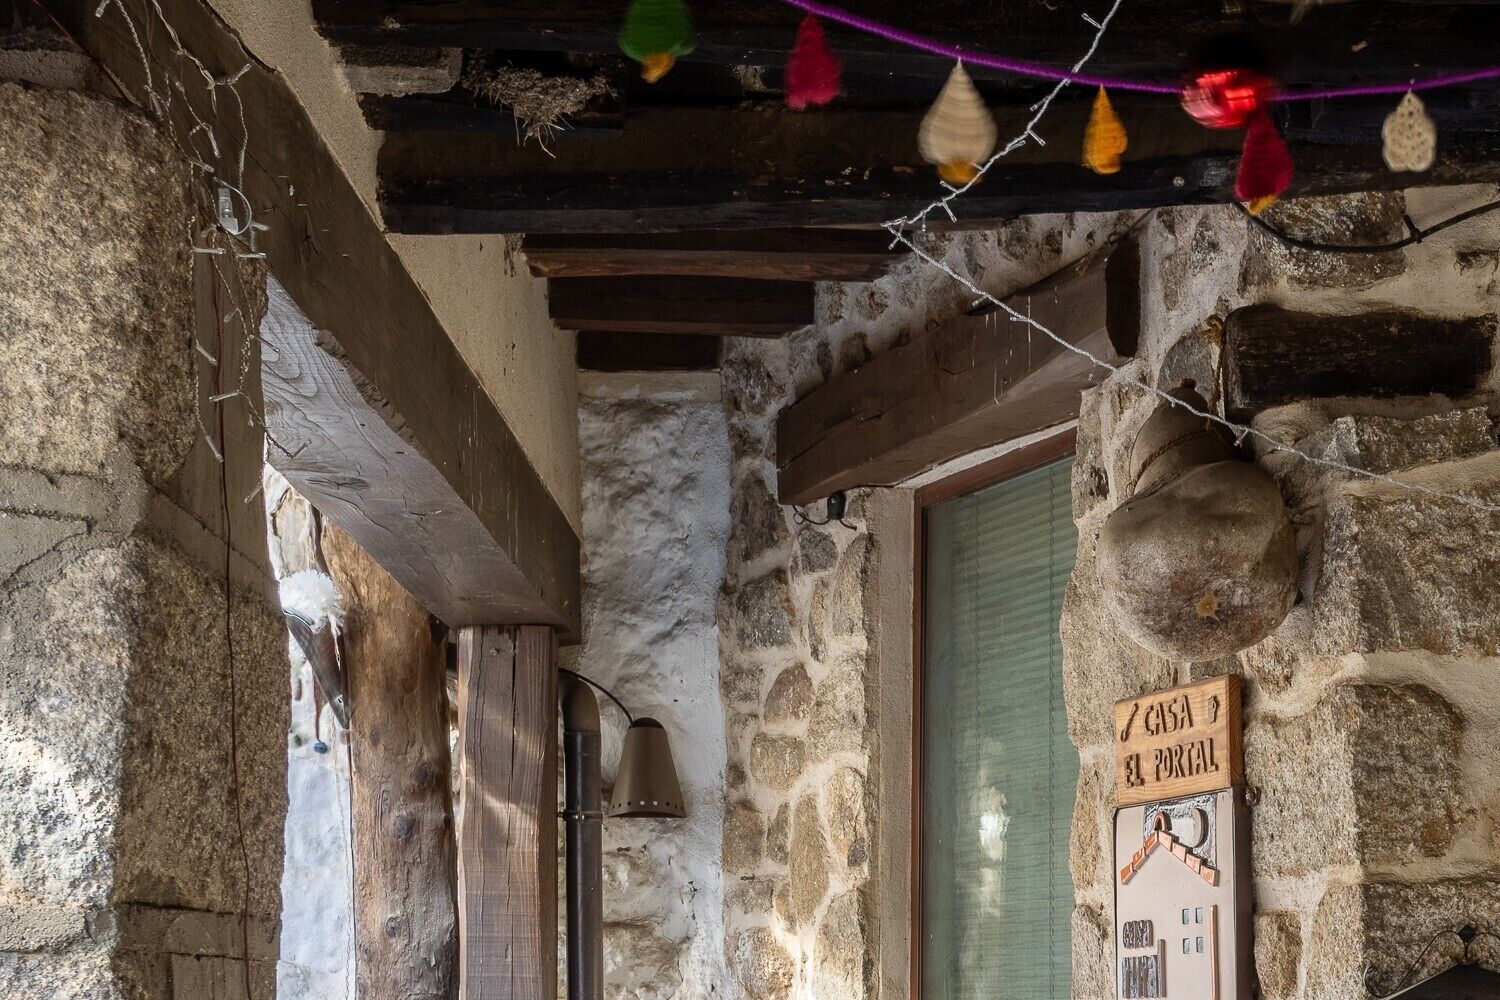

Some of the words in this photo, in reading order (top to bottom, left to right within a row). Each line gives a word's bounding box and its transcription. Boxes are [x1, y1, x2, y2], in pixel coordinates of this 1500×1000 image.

[1144, 694, 1193, 737] CASA
[1123, 753, 1145, 788] EL
[1153, 737, 1219, 782] PORTAL
